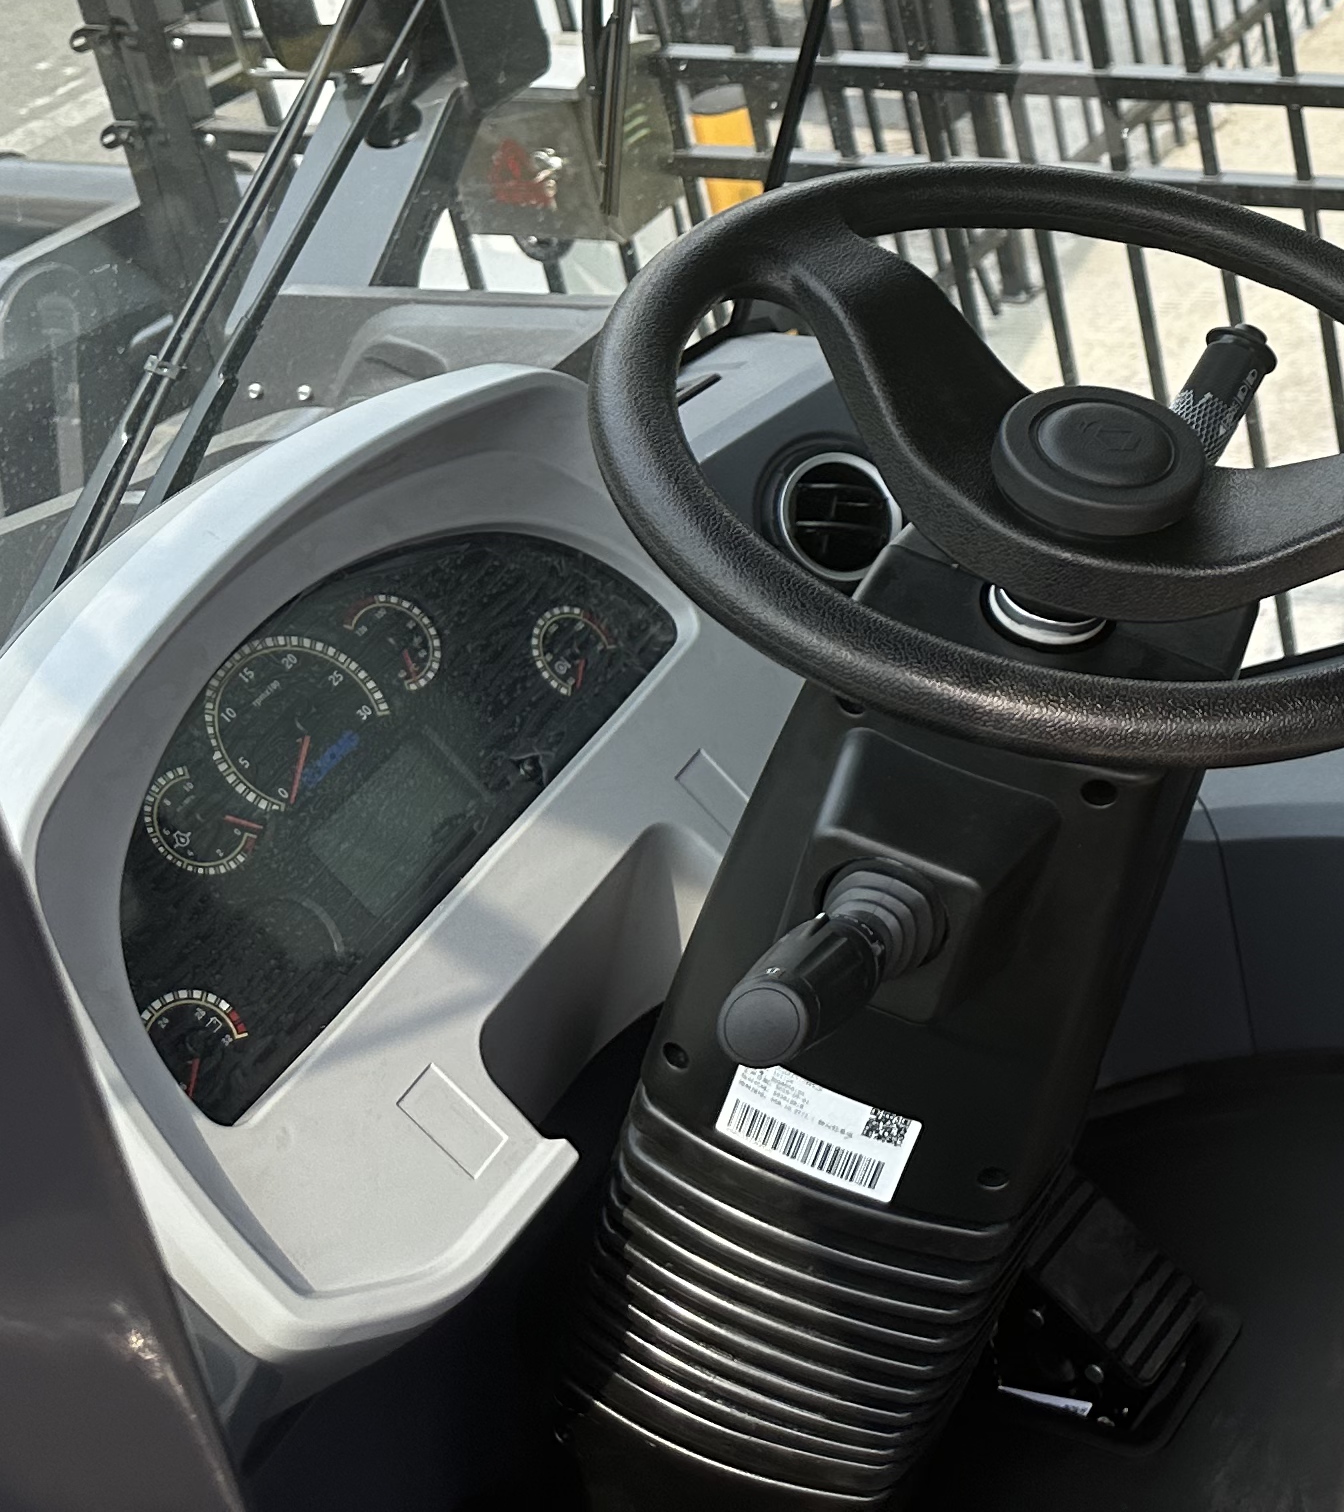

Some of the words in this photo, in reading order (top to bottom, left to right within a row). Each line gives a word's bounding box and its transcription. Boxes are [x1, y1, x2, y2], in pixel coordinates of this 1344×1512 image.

[281, 653, 298, 670] 20
[238, 667, 256, 683] 15
[327, 670, 345, 687] 25
[220, 707, 238, 723] 10
[356, 704, 373, 721] 30
[238, 756, 251, 770] 5
[277, 787, 290, 799] 0
